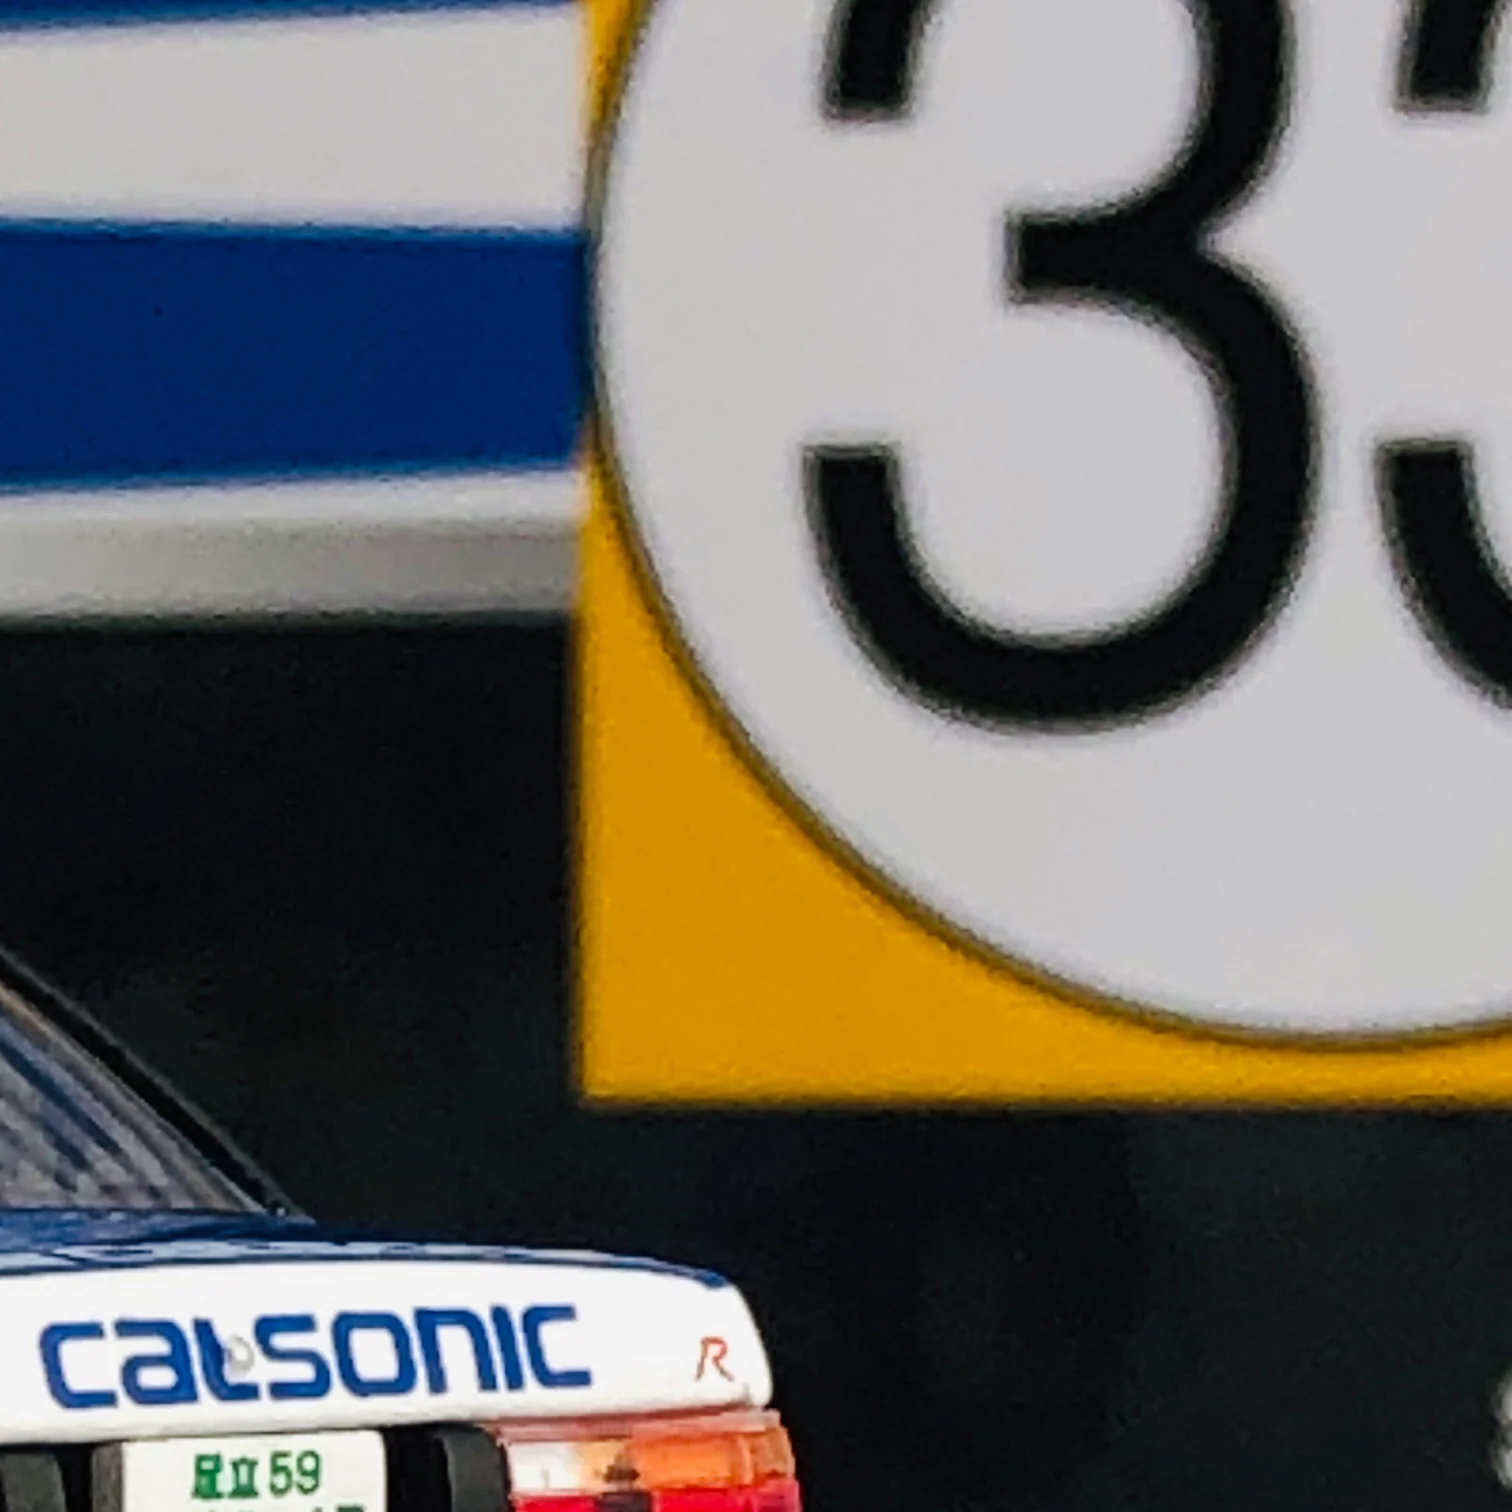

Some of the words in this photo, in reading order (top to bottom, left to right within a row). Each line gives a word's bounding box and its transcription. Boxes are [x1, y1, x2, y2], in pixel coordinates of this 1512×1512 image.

[804, 0, 1512, 733] 3
[694, 1335, 736, 1383] R
[268, 1449, 322, 1497] 59
